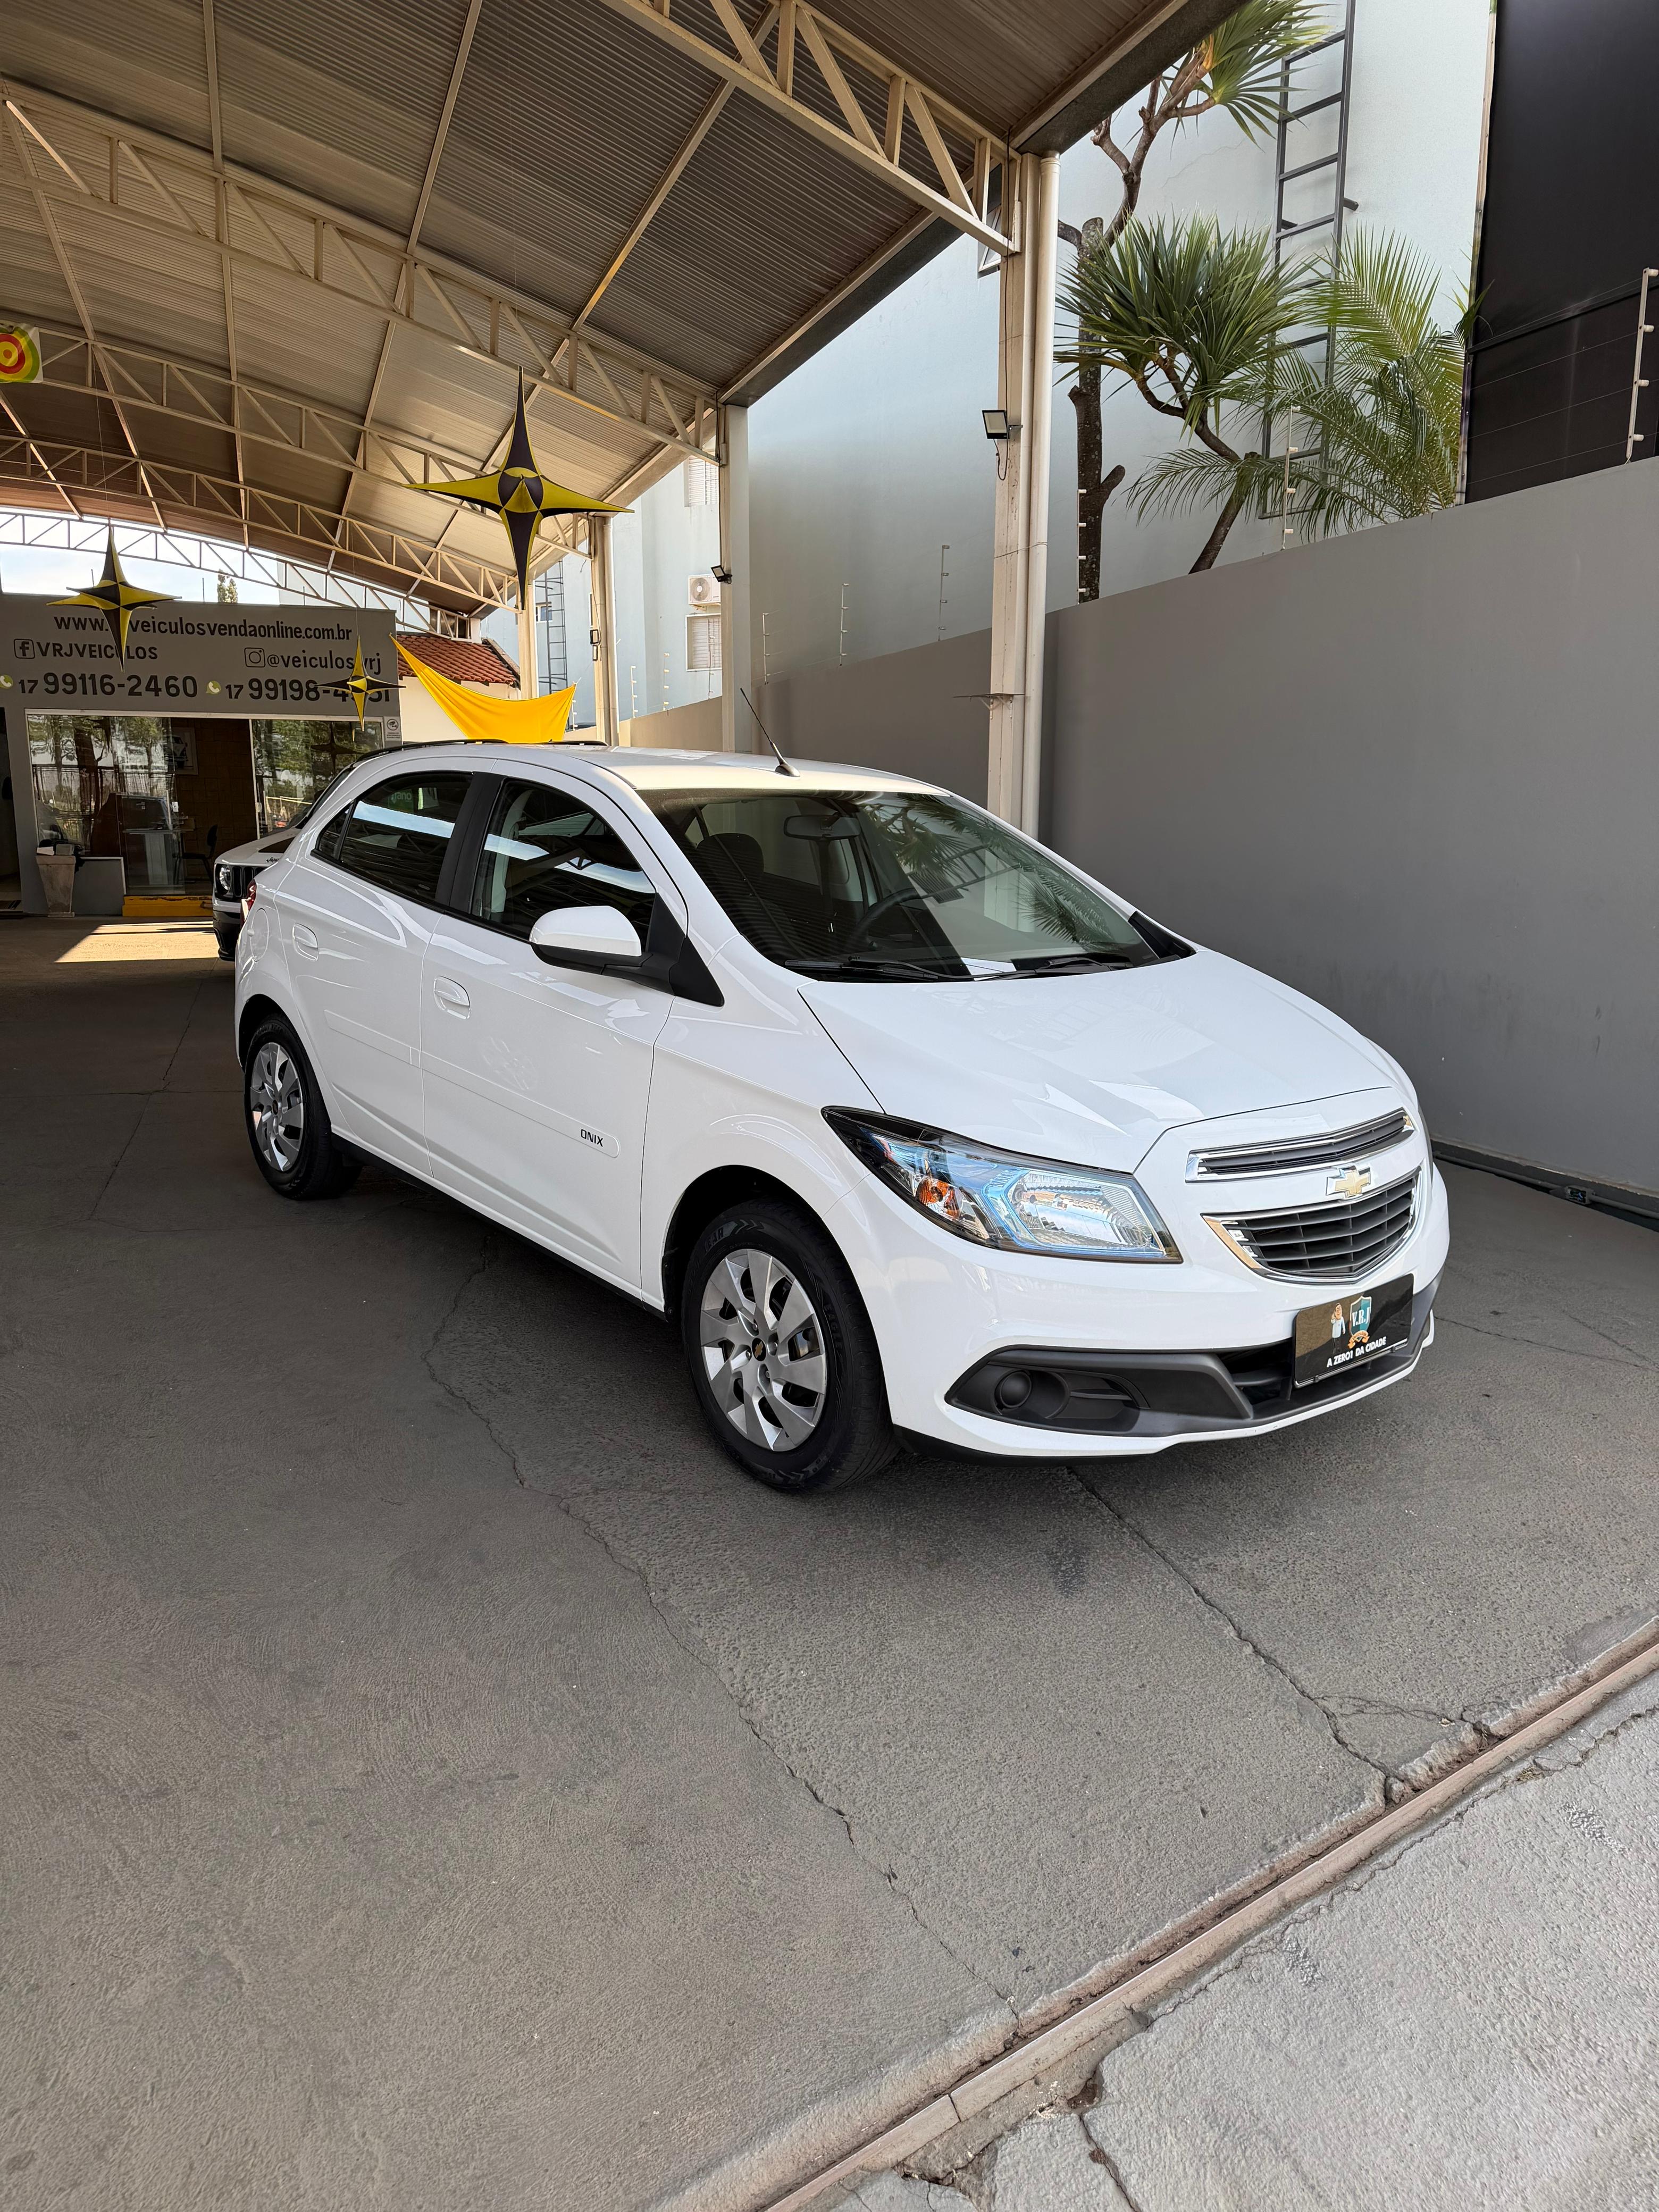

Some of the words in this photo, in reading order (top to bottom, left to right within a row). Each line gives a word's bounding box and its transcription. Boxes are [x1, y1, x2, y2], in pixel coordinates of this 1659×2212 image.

[36, 641, 158, 659] VRJVEICLOS
[19, 679, 38, 693] 17
[43, 672, 198, 697] 99116-2460
[225, 684, 244, 699] 17
[581, 1128, 603, 1147] ONIX
[1327, 1358, 1332, 1368] A
[1334, 1350, 1353, 1365] ZERO1
[1355, 1347, 1364, 1357] DA
[1365, 1336, 1387, 1353] CIDADE
